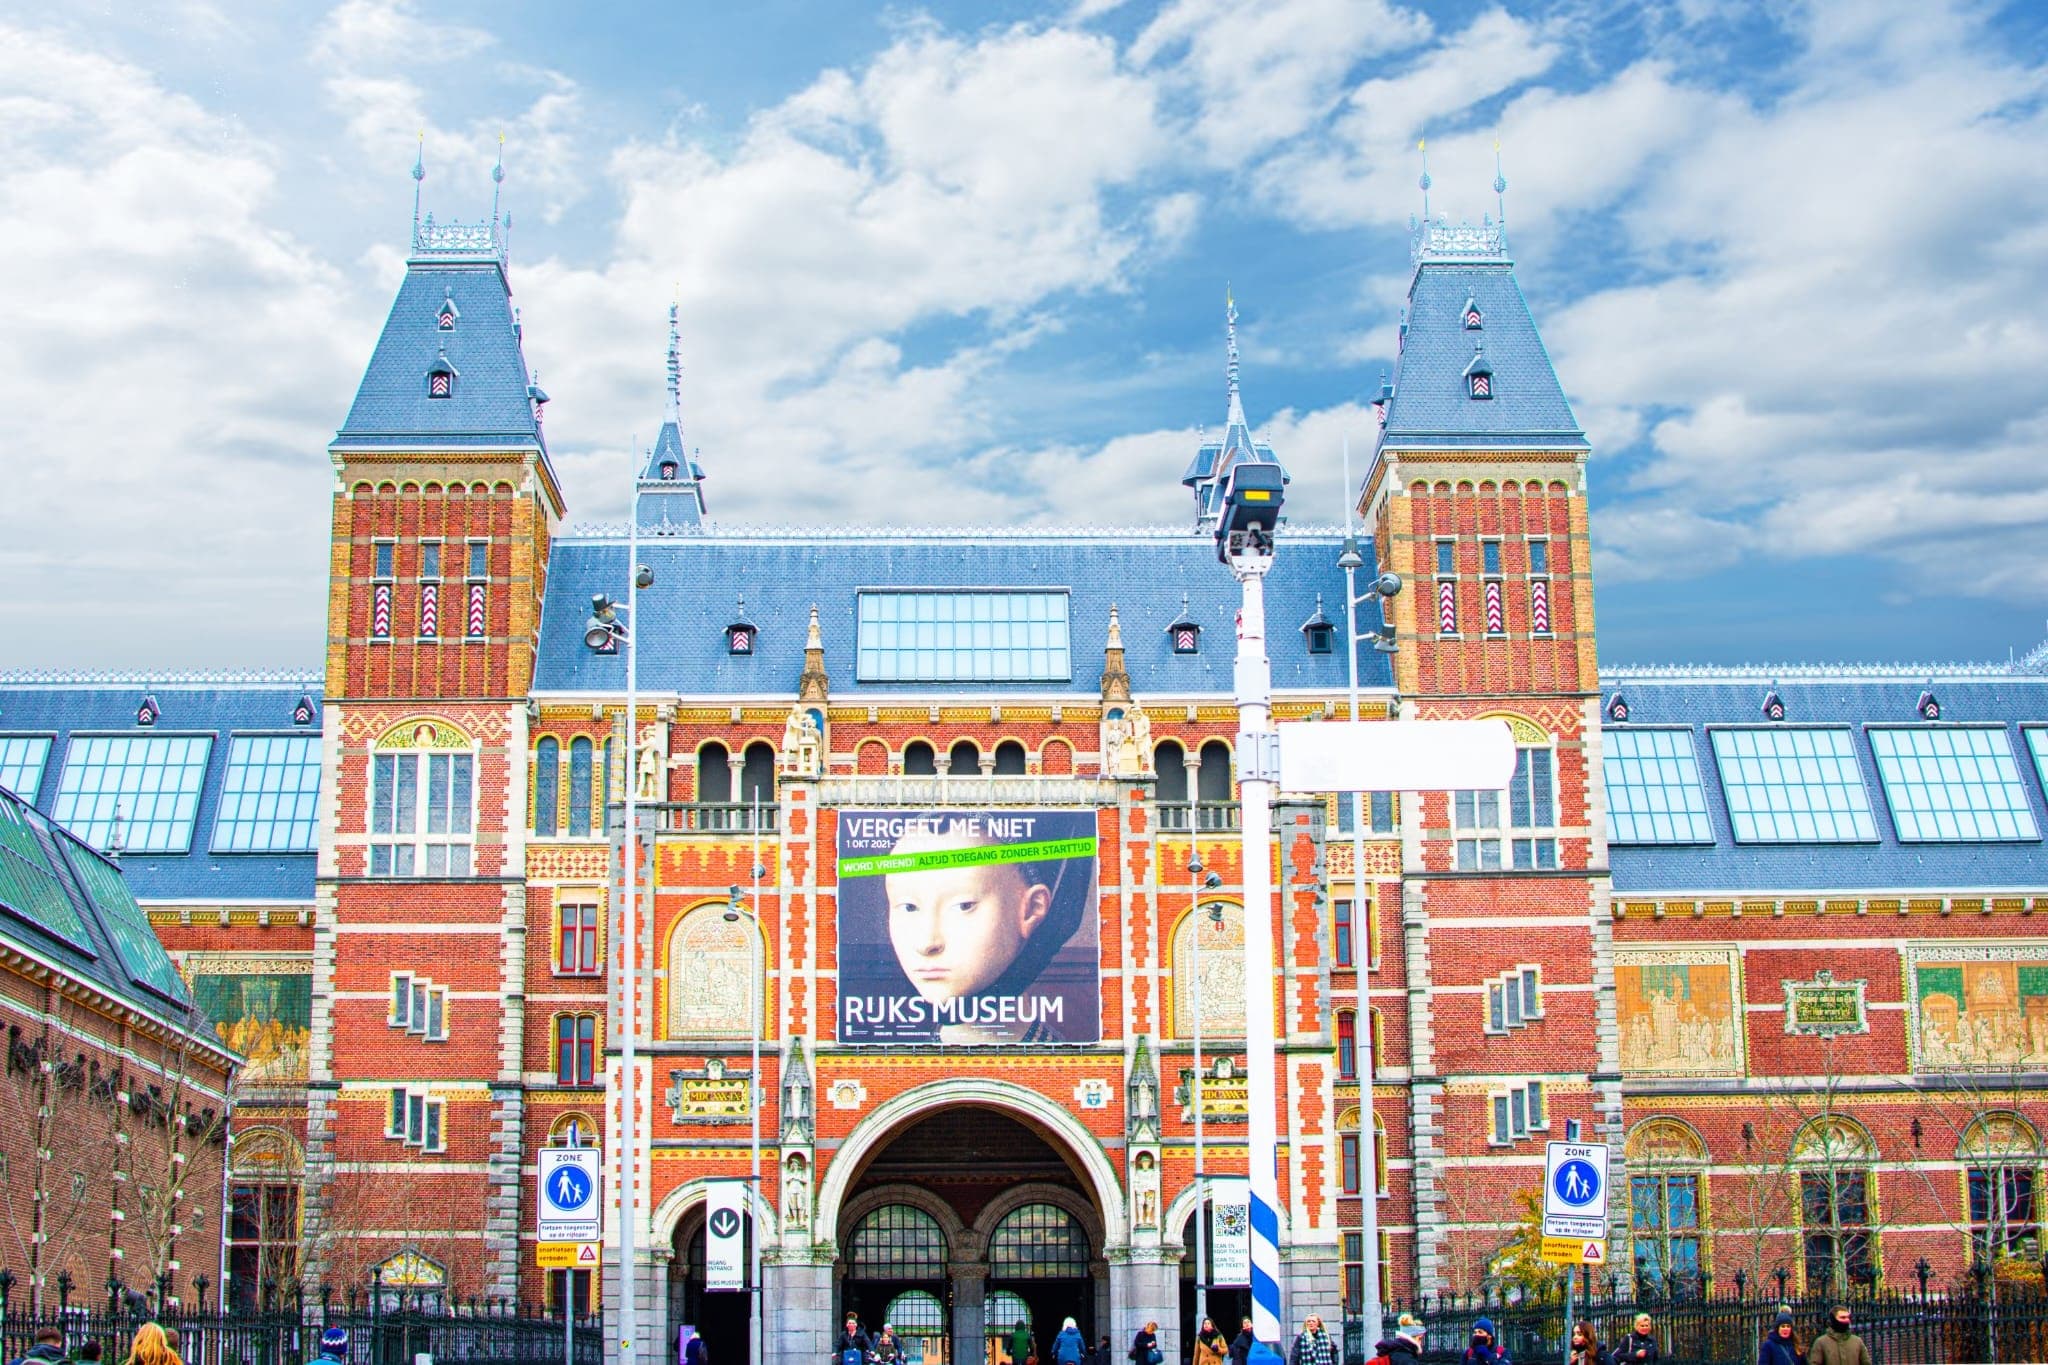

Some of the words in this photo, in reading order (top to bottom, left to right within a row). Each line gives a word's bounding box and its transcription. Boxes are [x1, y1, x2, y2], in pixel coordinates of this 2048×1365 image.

[846, 818, 943, 838] VERGEET
[949, 818, 981, 838] ME
[988, 818, 1036, 838] NIET
[852, 840, 869, 849] OKT
[843, 861, 873, 873] WORD
[877, 858, 916, 871] VRIEND!
[951, 849, 998, 864] TOEGANG
[1000, 846, 1040, 860] ZONDER
[932, 995, 1063, 1023] MUSEUM
[555, 1154, 583, 1162] ZONE
[1564, 1147, 1592, 1157] ZONE
